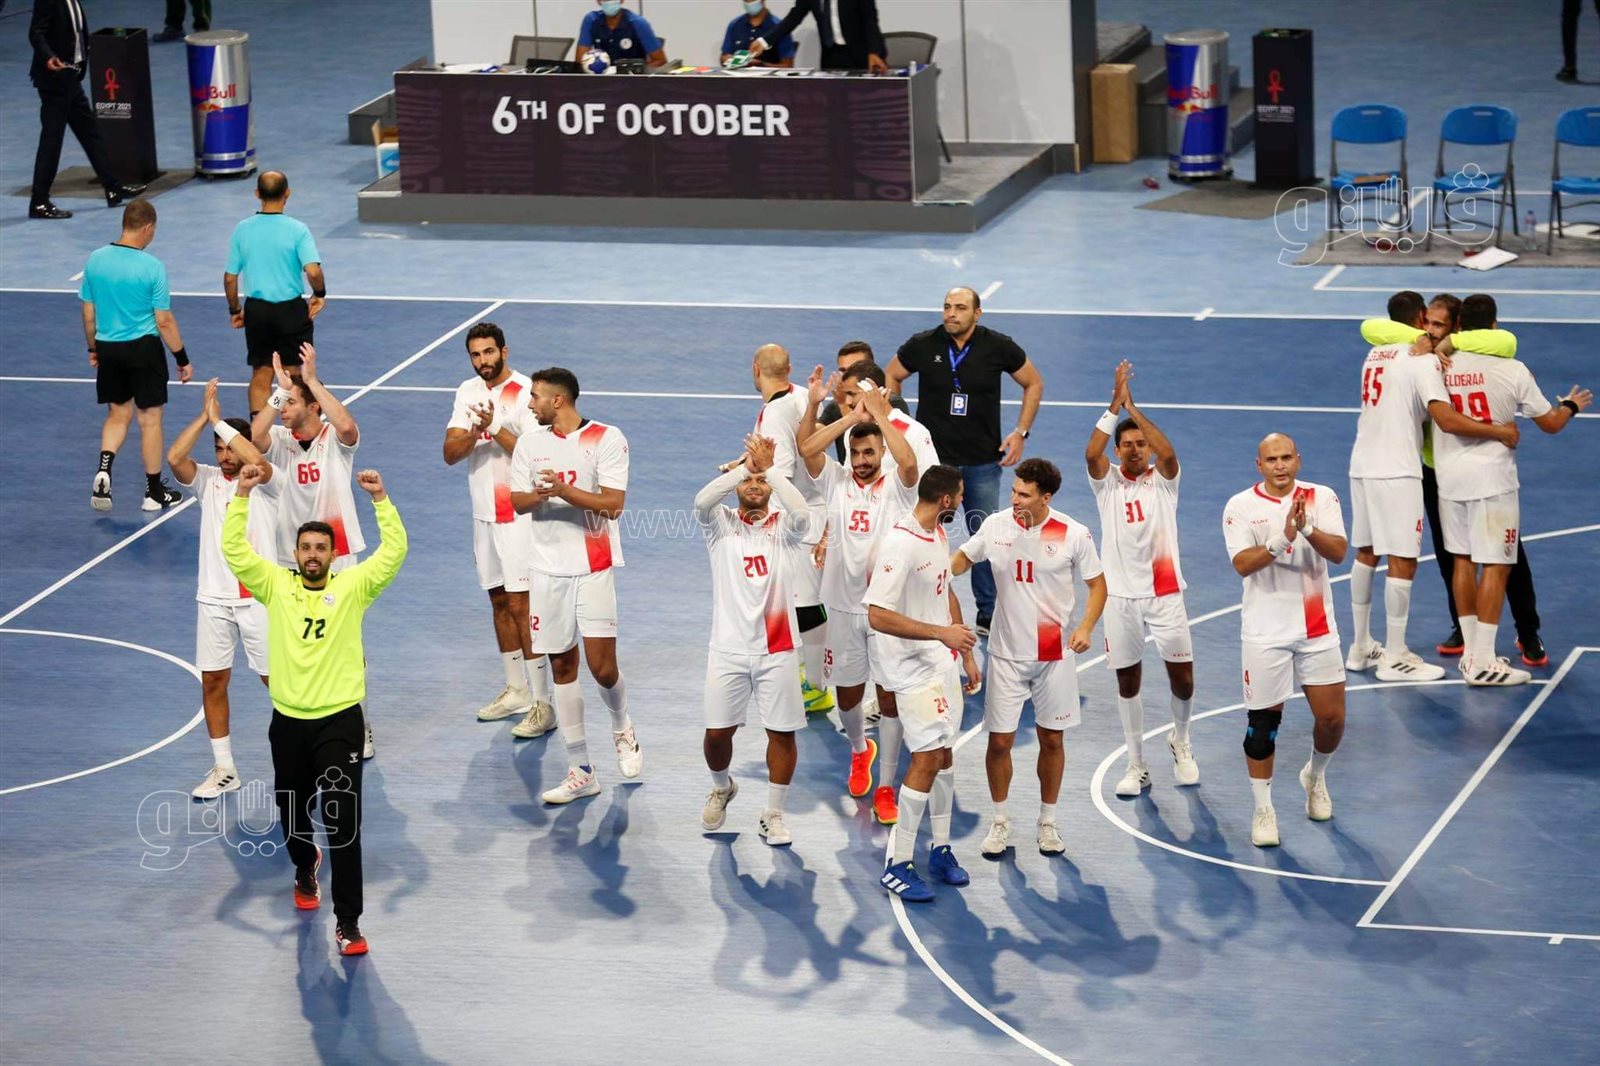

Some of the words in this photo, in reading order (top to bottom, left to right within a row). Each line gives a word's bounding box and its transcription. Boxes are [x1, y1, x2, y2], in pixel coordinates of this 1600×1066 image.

[209, 84, 237, 99] Bull
[557, 102, 606, 136] OF
[616, 102, 791, 137] OCTOBER
[1362, 367, 1385, 407] 45
[953, 396, 965, 409] B
[297, 461, 321, 484] 66
[848, 509, 870, 533] 55
[1125, 499, 1145, 523] 31
[1504, 528, 1517, 543] 39
[743, 554, 769, 578] 20
[1015, 559, 1034, 584] 11
[302, 617, 326, 640] 72
